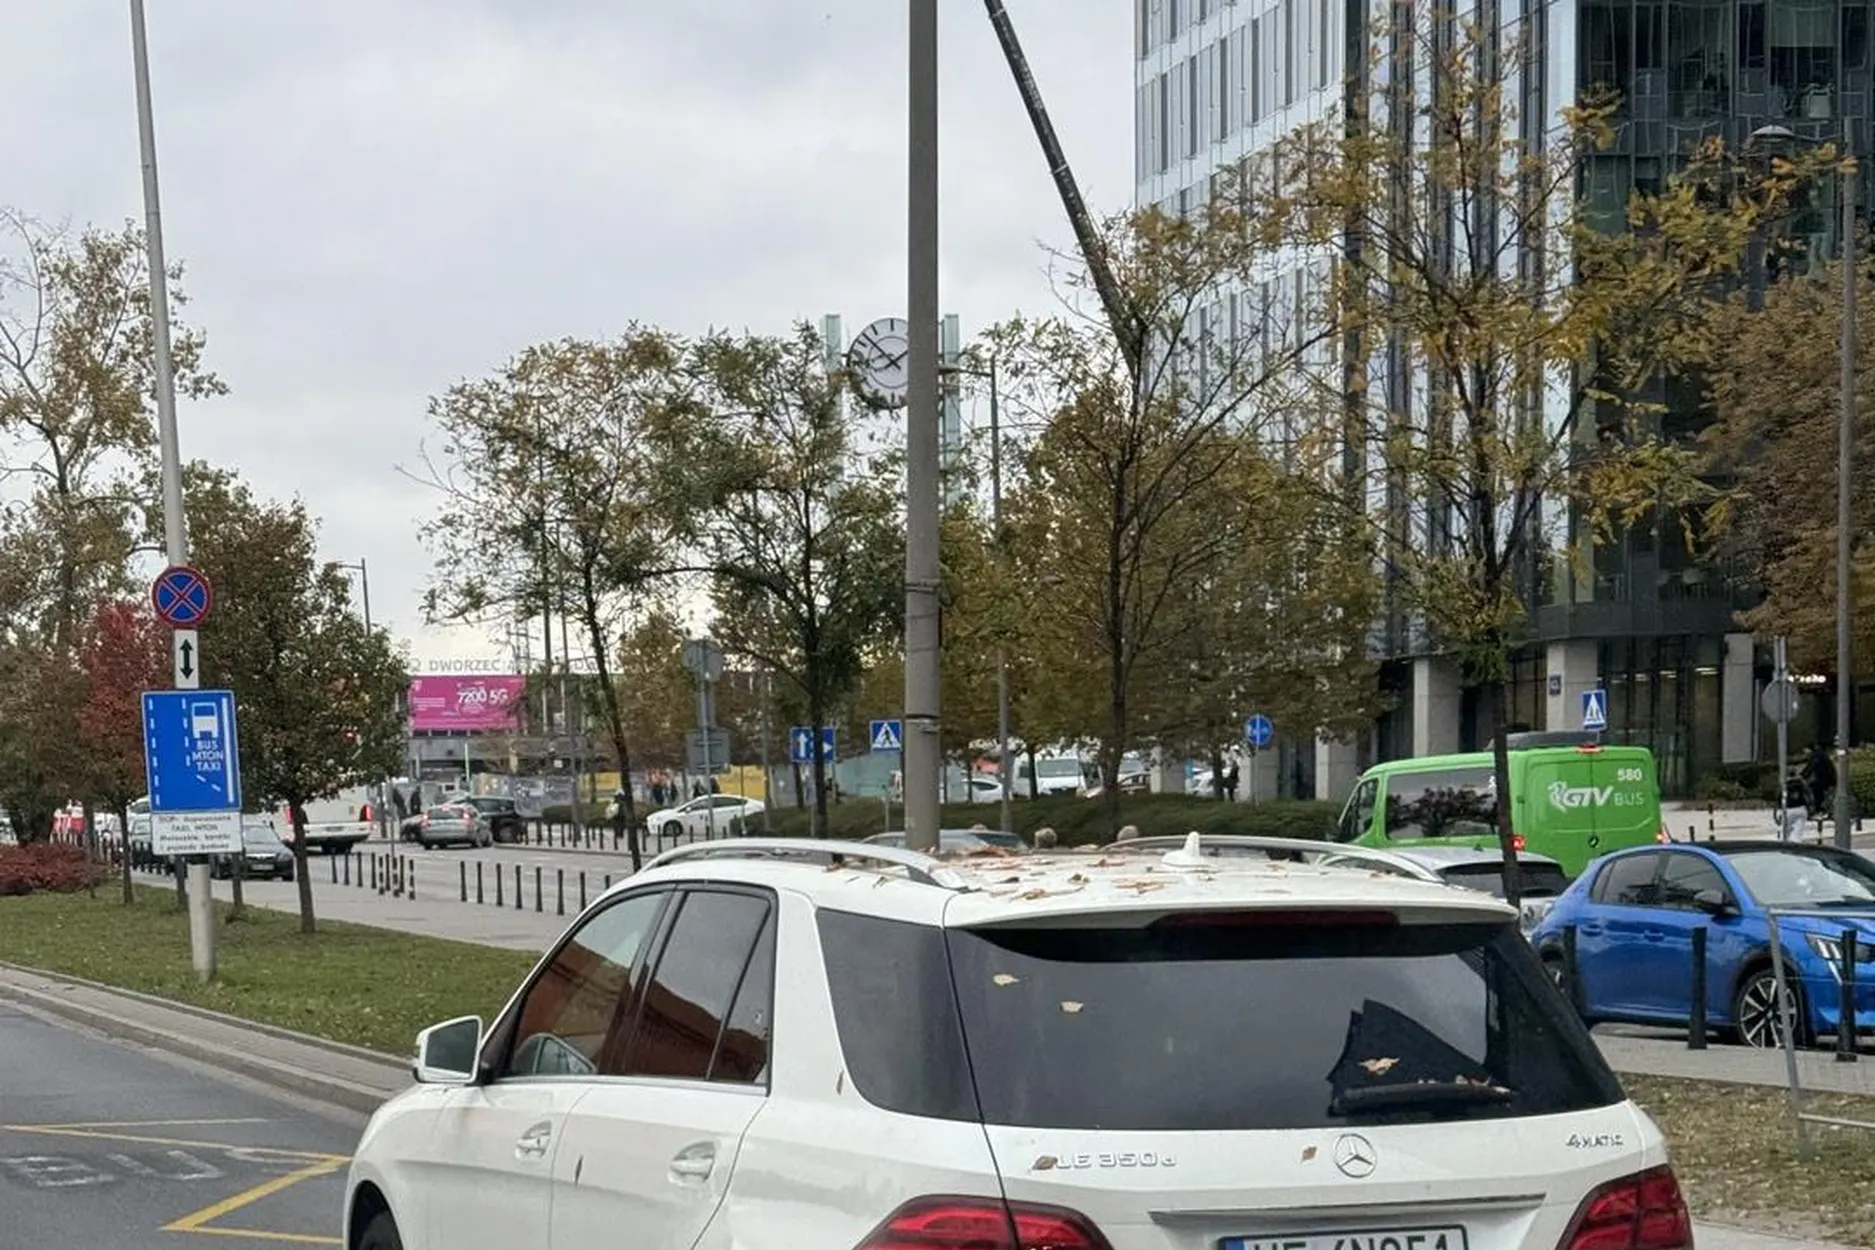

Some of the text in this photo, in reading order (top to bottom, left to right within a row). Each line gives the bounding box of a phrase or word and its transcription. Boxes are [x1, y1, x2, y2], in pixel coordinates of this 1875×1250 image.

[428, 658, 500, 672] DWORZEC
[489, 688, 509, 705] 5G
[196, 740, 218, 750] BUS
[192, 750, 224, 761] MTON
[196, 761, 221, 772] TAXI
[1617, 768, 1643, 781] 580
[1614, 792, 1645, 806] BUS
[1034, 1152, 1093, 1170] LE
